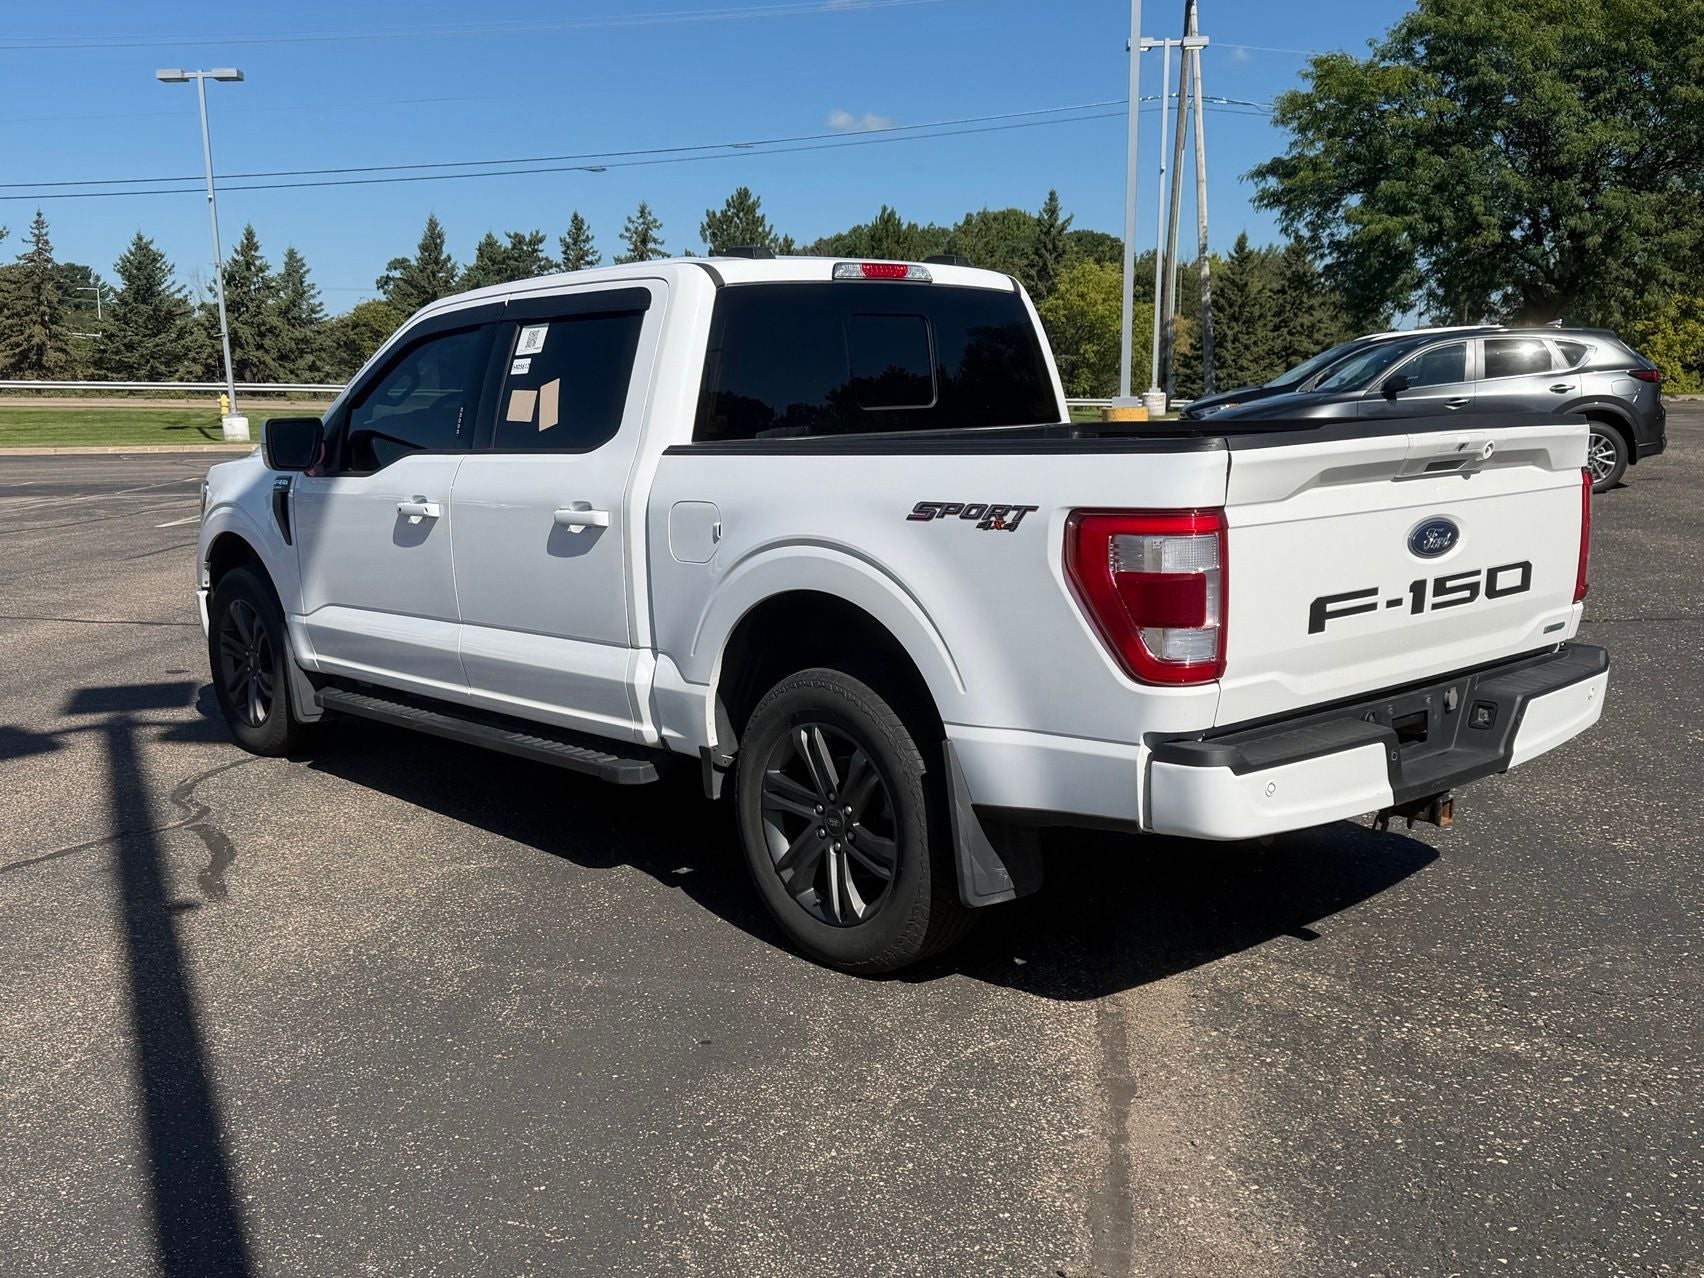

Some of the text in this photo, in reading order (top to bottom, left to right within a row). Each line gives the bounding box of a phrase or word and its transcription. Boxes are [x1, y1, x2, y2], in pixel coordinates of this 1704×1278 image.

[905, 501, 1039, 521] SPORT
[1422, 527, 1452, 551] Ford
[1308, 560, 1532, 635] F-150
